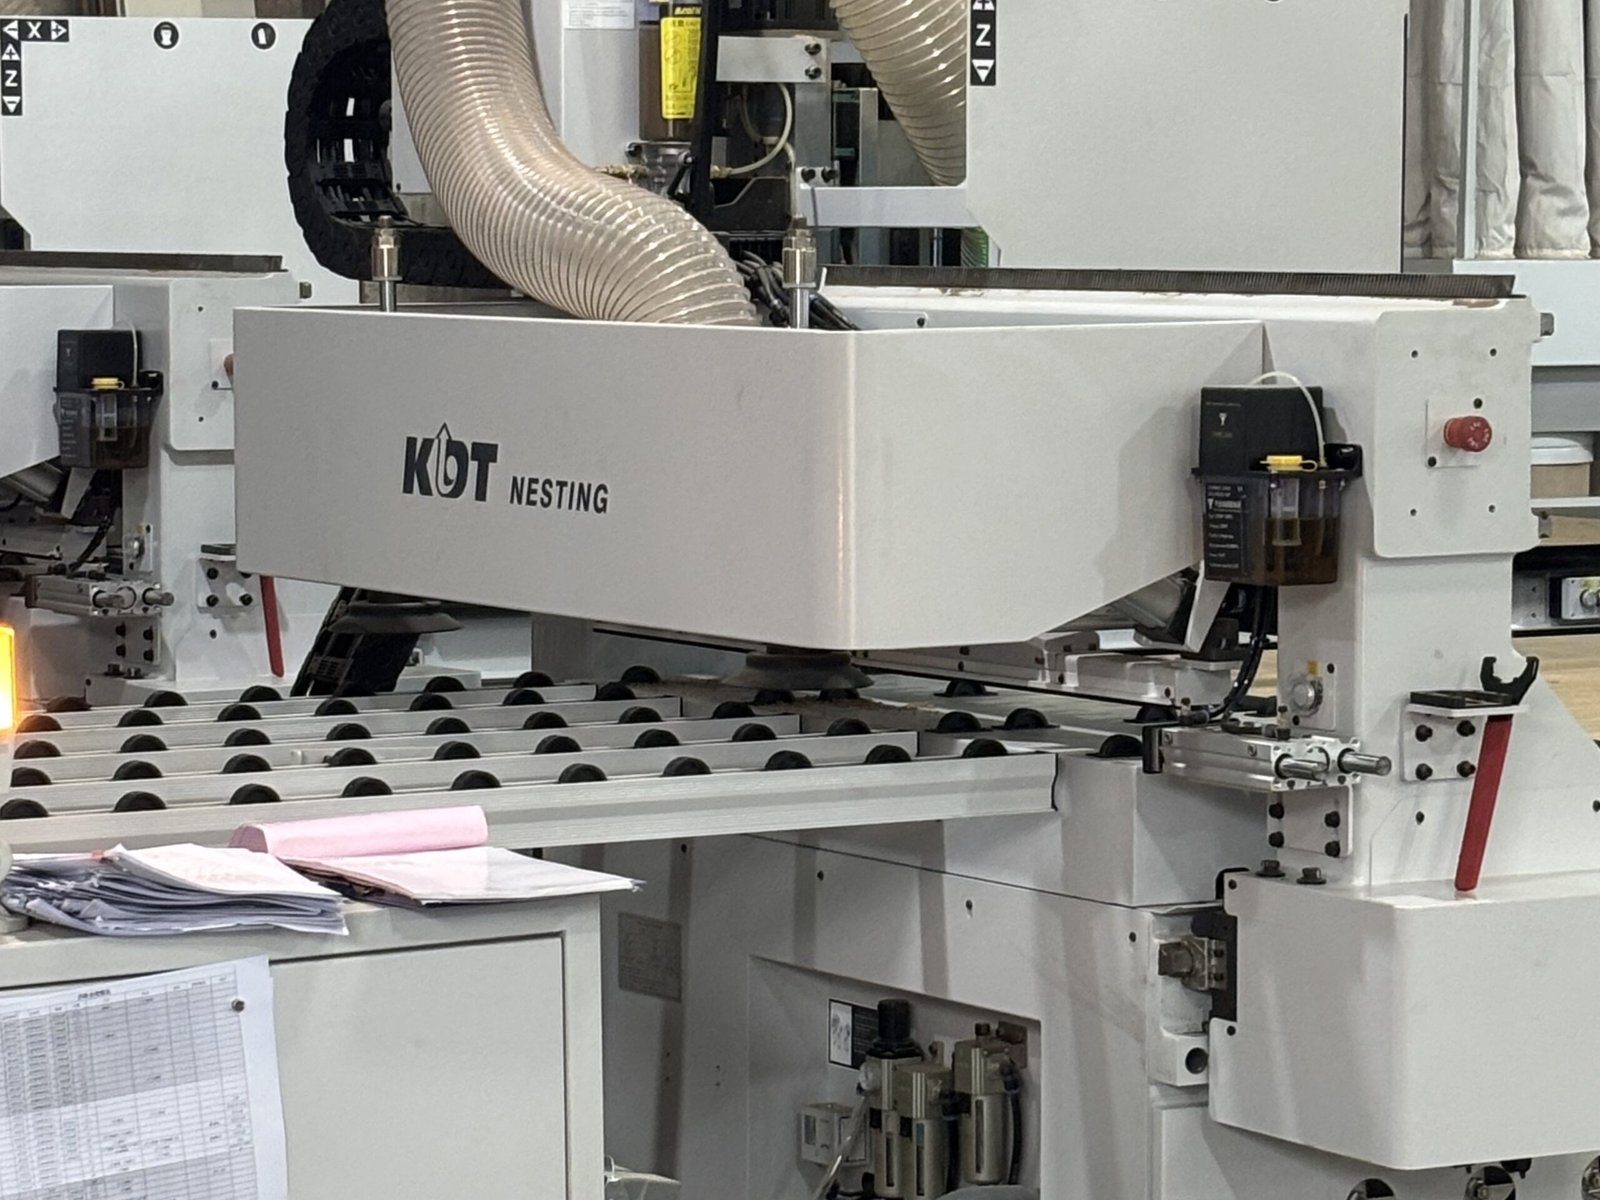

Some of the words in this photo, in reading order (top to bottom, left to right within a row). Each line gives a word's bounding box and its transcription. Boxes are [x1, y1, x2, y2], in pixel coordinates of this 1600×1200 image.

[26, 21, 42, 39] X
[975, 23, 991, 47] Z
[4, 69, 19, 88] Z
[402, 422, 499, 502] KDT
[509, 475, 609, 514] NESTING
